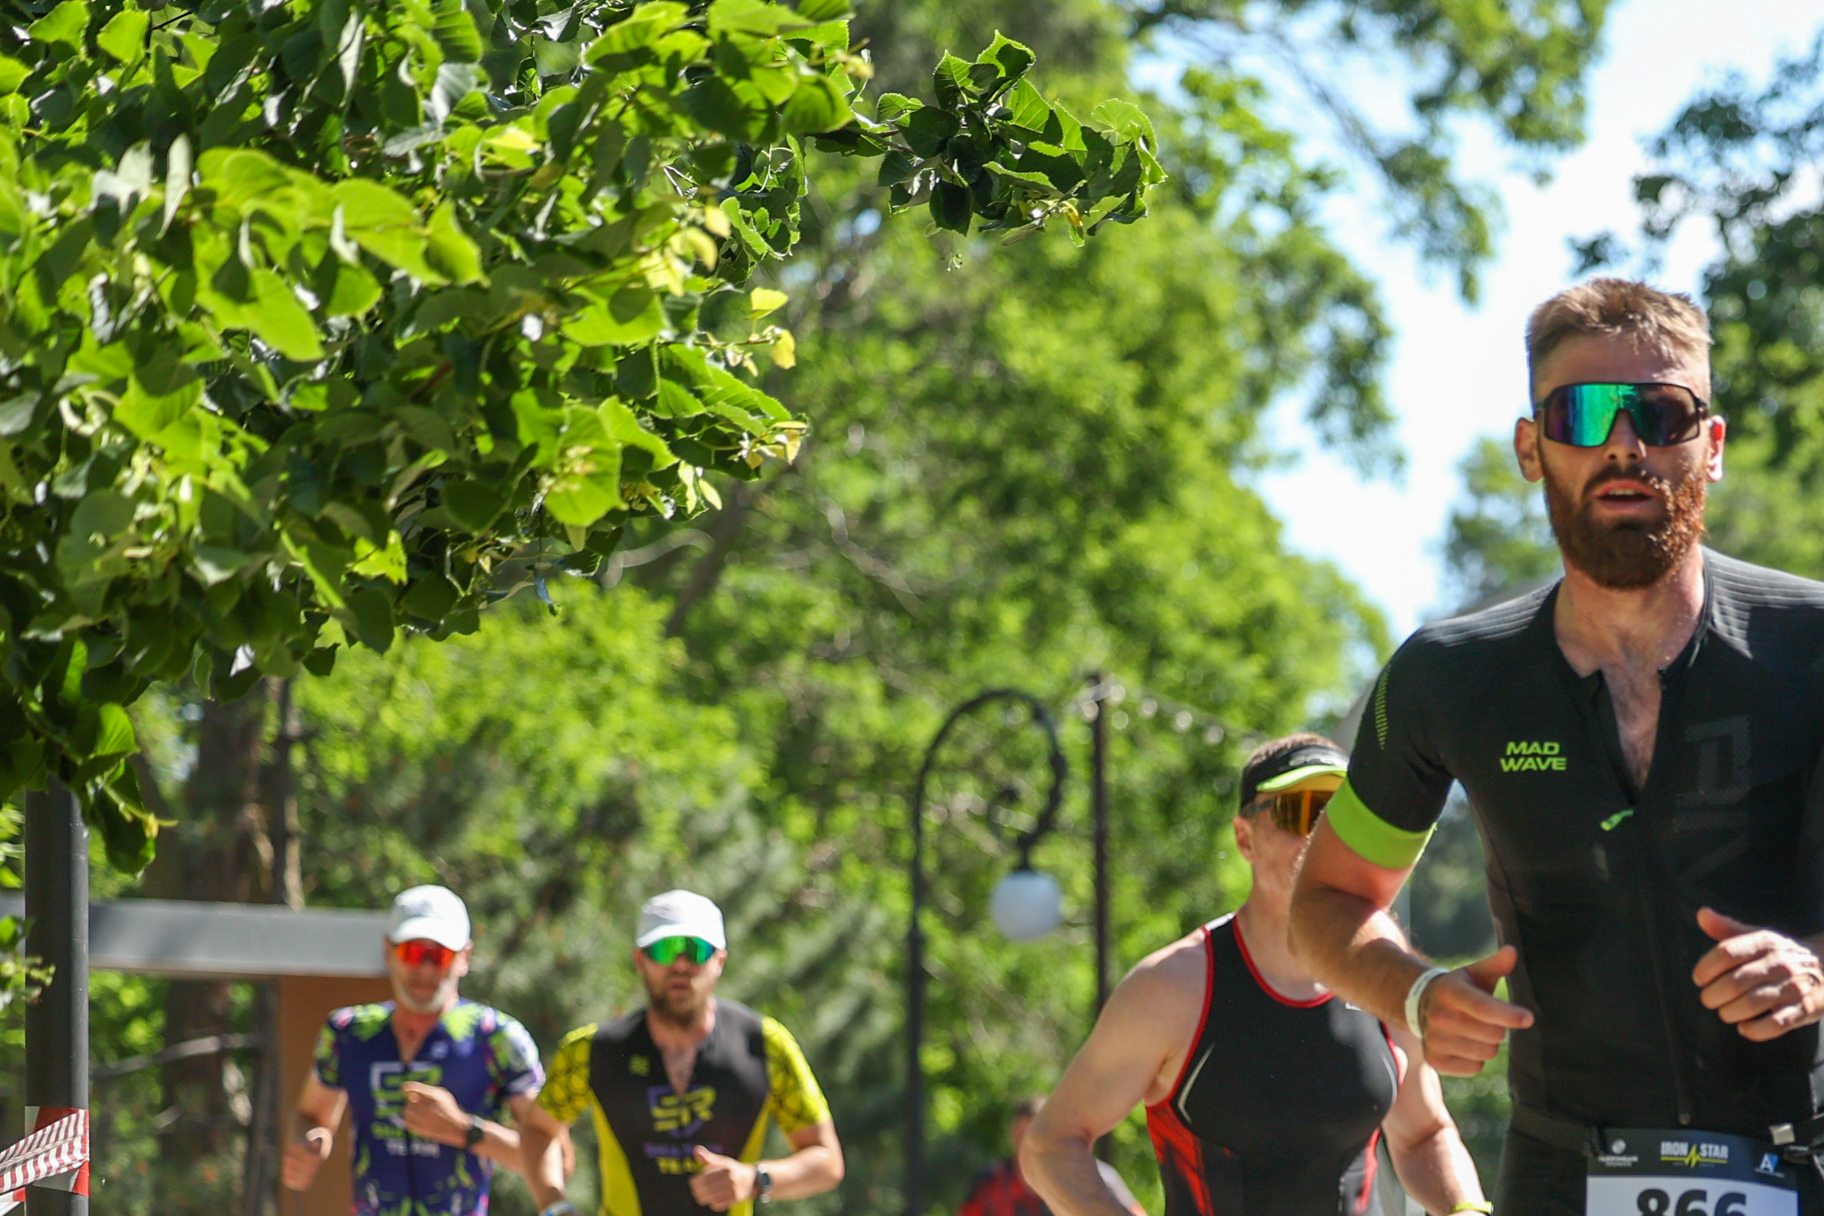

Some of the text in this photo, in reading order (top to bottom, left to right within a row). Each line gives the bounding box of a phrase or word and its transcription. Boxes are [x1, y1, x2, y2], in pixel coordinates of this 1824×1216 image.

[1505, 741, 1560, 755] MAD
[1500, 757, 1567, 772] WAVE
[1660, 1141, 1729, 1160] IRON STAR
